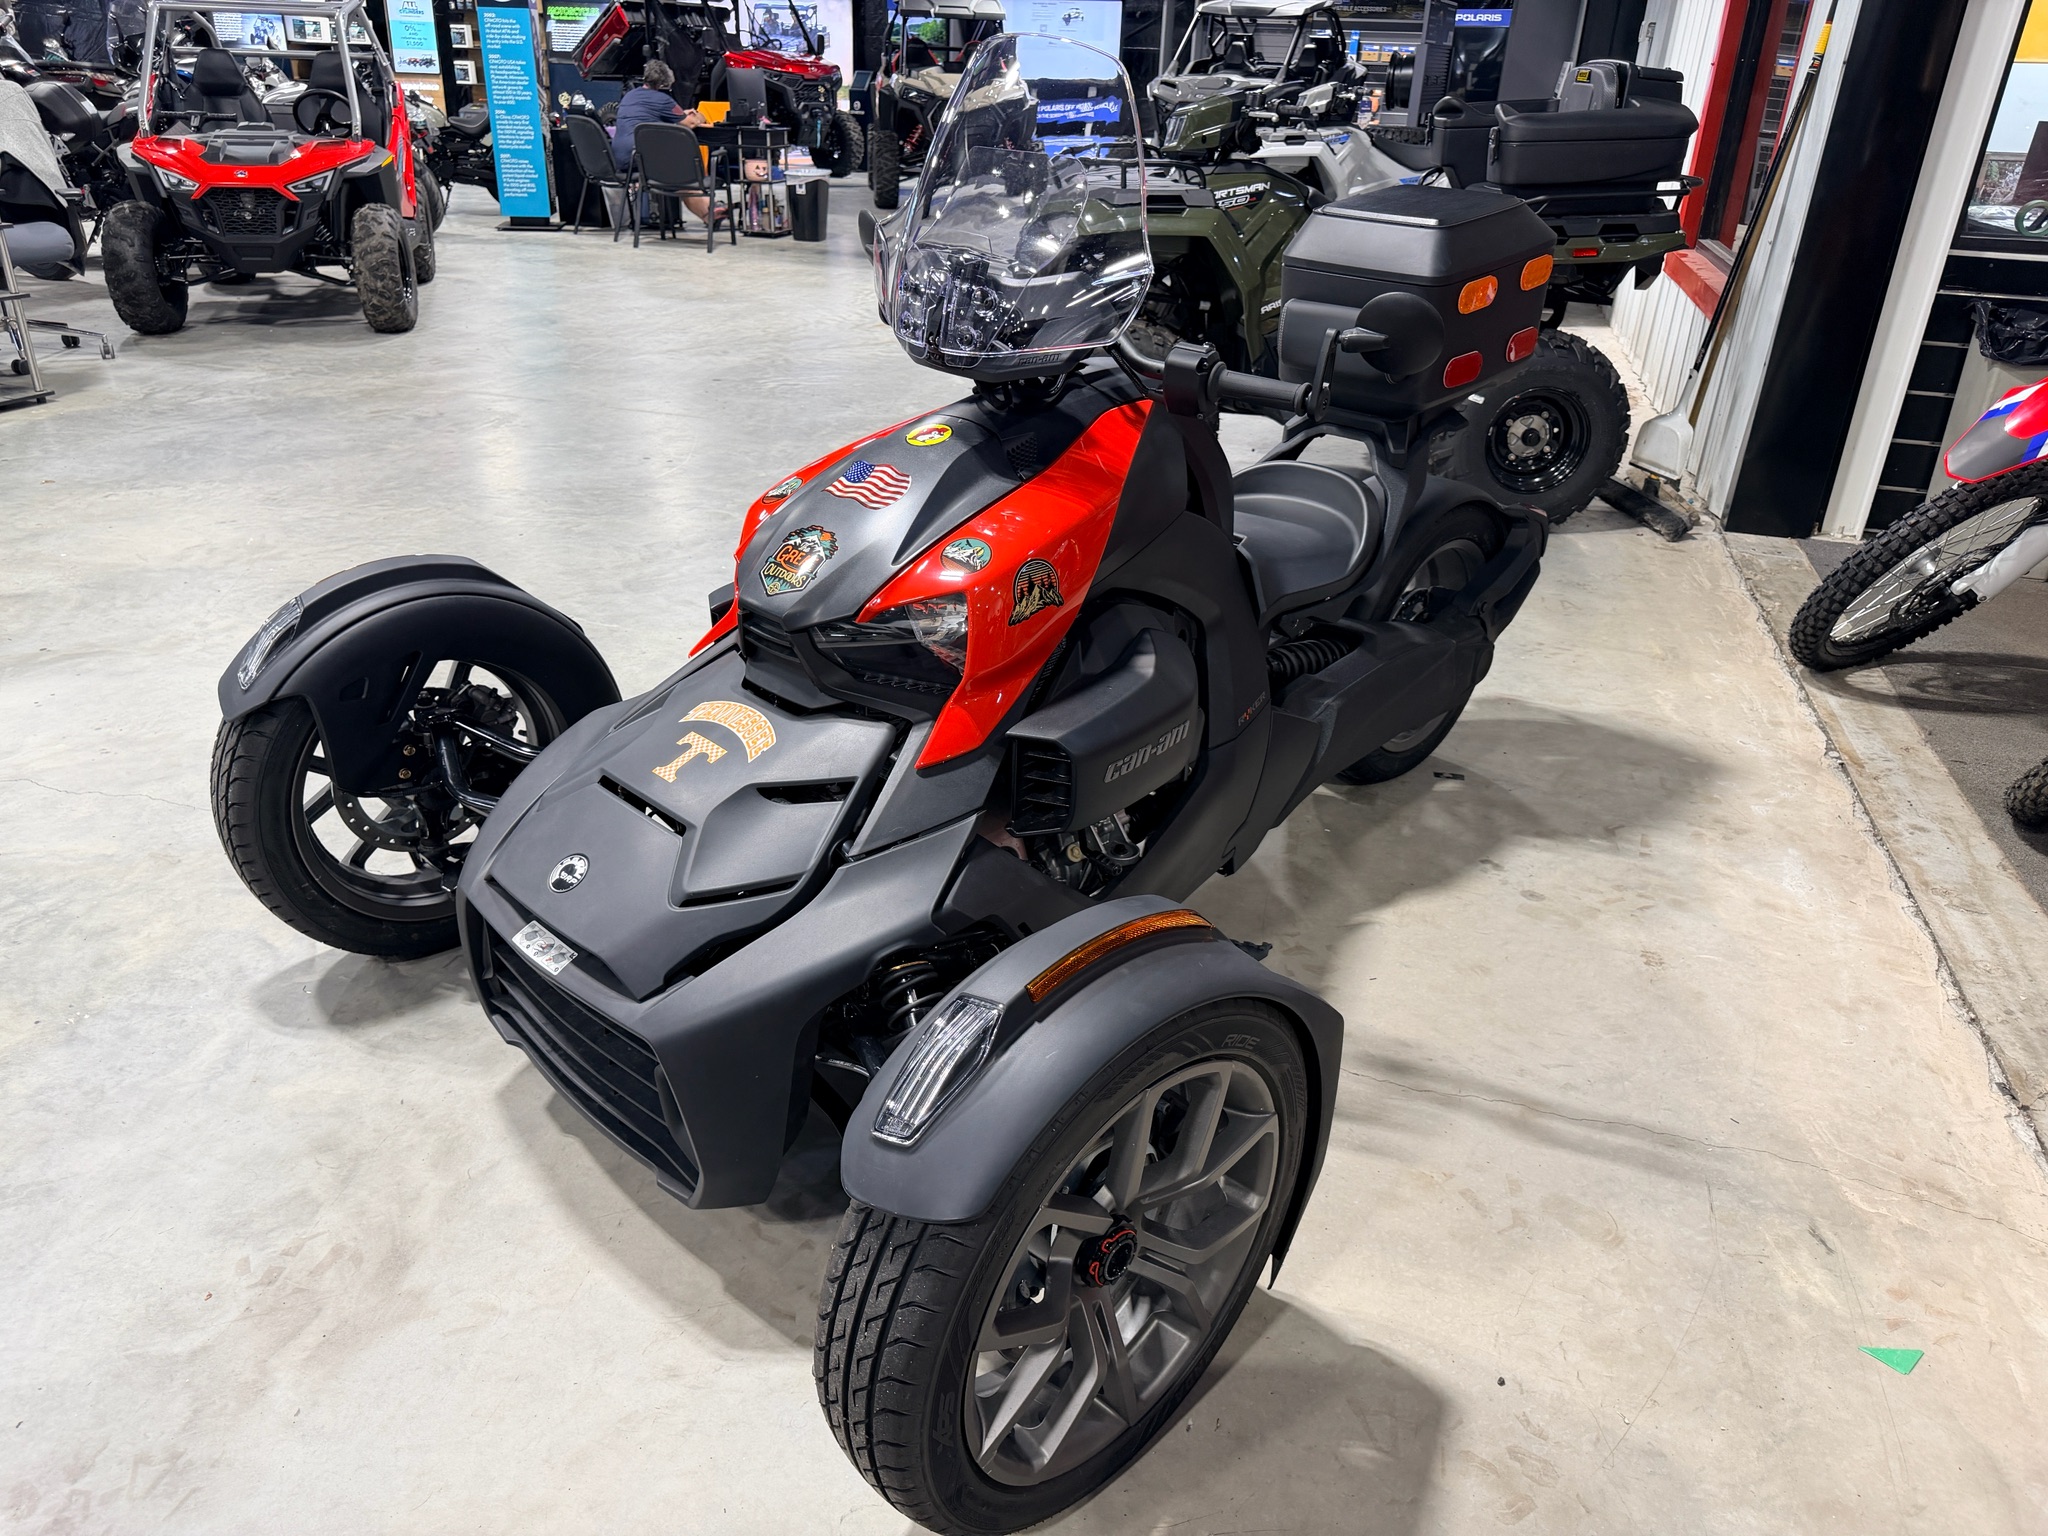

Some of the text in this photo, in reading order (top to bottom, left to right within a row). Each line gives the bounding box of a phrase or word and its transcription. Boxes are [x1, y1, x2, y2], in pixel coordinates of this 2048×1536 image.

[764, 563, 806, 588] OUTDOORS
[652, 732, 728, 783] T
[678, 701, 776, 763] TENNESSEE
[1104, 719, 1190, 783] can-am
[1221, 1034, 1261, 1050] RIDE
